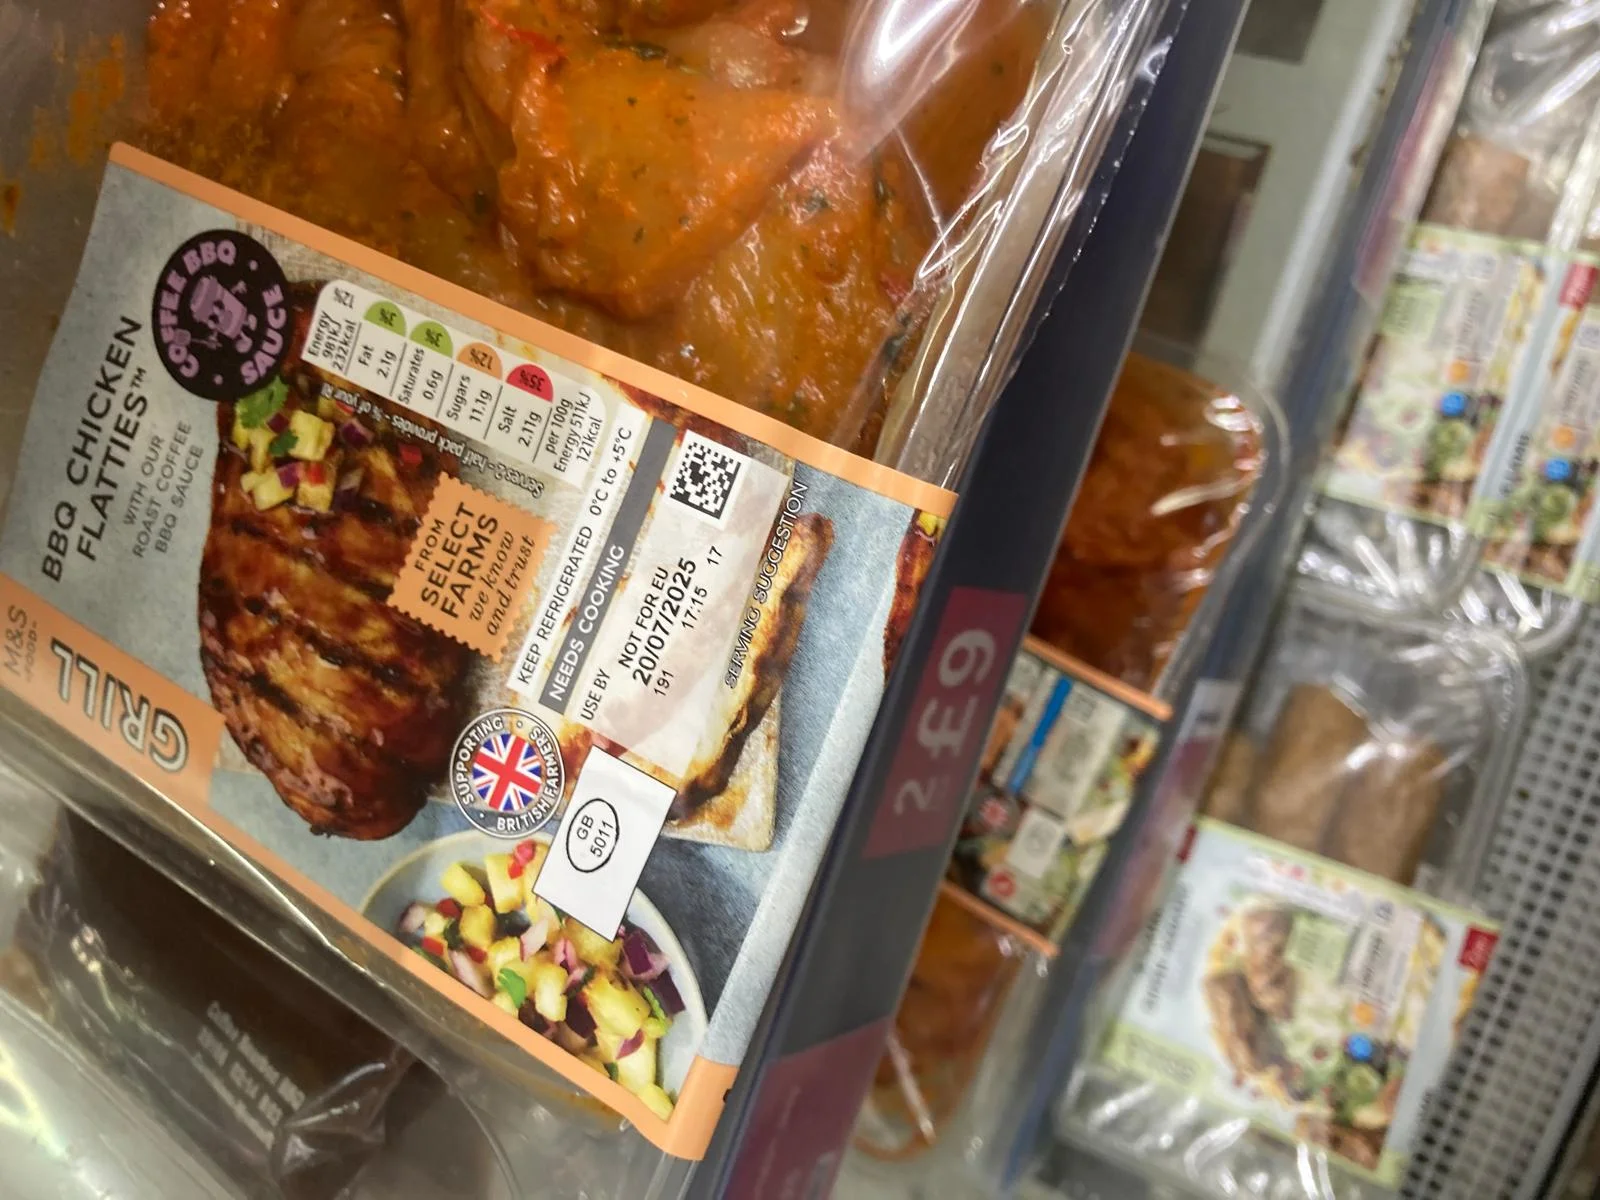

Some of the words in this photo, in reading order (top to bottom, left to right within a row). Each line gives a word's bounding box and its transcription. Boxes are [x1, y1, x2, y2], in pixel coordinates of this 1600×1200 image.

[159, 268, 200, 377] COFFEE
[181, 240, 237, 274] BBQ
[331, 287, 356, 308] 12%
[376, 308, 397, 326] 3%
[239, 283, 288, 385] SAUCE
[308, 310, 336, 357] Energy
[322, 319, 344, 360] 981kJ
[331, 319, 357, 371] 232kcal
[357, 343, 375, 367] Fat
[422, 328, 443, 347] 3%
[467, 348, 496, 370] 12%
[376, 349, 398, 379] 2.1g
[397, 347, 428, 405] Saturates
[421, 368, 446, 401] 0.6g
[516, 369, 546, 392] 35%
[445, 374, 473, 421] Sugars
[469, 389, 495, 423] 11.1g
[496, 405, 518, 434] Salt
[551, 397, 574, 430] 100g
[40, 499, 79, 583] BBQ
[63, 315, 143, 488] CHICKEN
[390, 414, 438, 444] provides
[435, 435, 465, 458] pack
[518, 411, 544, 448] 2.11g
[545, 428, 560, 455] per
[553, 428, 583, 473] Energy
[570, 391, 592, 428] 511kJ
[576, 416, 604, 464] 121kcal
[121, 481, 148, 526] WITH
[140, 434, 165, 478] OUR
[462, 448, 488, 471] half
[502, 466, 545, 497] Serves
[132, 497, 163, 559] ROAST
[155, 421, 192, 494] COFFEE
[154, 512, 180, 554] BBQ
[170, 444, 204, 508] SAUCE
[413, 518, 446, 573] FROM
[419, 501, 477, 608] SELECT
[439, 512, 500, 620] FARMS
[468, 590, 490, 622] we
[479, 531, 515, 590] know
[485, 589, 512, 636] and
[504, 534, 537, 590] trust
[518, 643, 544, 685] KEEP
[537, 525, 594, 641] REFRIGERATED
[602, 466, 618, 486] to
[723, 606, 762, 690] SERVING
[751, 479, 809, 605] SUGGESTION
[548, 637, 585, 702] NEEDS
[577, 542, 626, 635] COOKING
[617, 631, 642, 669] NOT
[634, 591, 659, 629] FOR
[651, 566, 670, 591] EU
[631, 556, 699, 687] 20/07/2025
[653, 668, 675, 698] 191
[680, 584, 709, 632] 17:15
[706, 545, 724, 568] 17
[52, 637, 188, 774] GRILL
[580, 689, 604, 722] USE
[594, 668, 612, 691] BY
[914, 628, 995, 756] £9
[456, 717, 506, 803] SUPPORTING
[495, 799, 551, 833] BRITISH
[531, 725, 561, 799] FARMERS
[575, 814, 595, 841] GB
[589, 820, 614, 858] 5011
